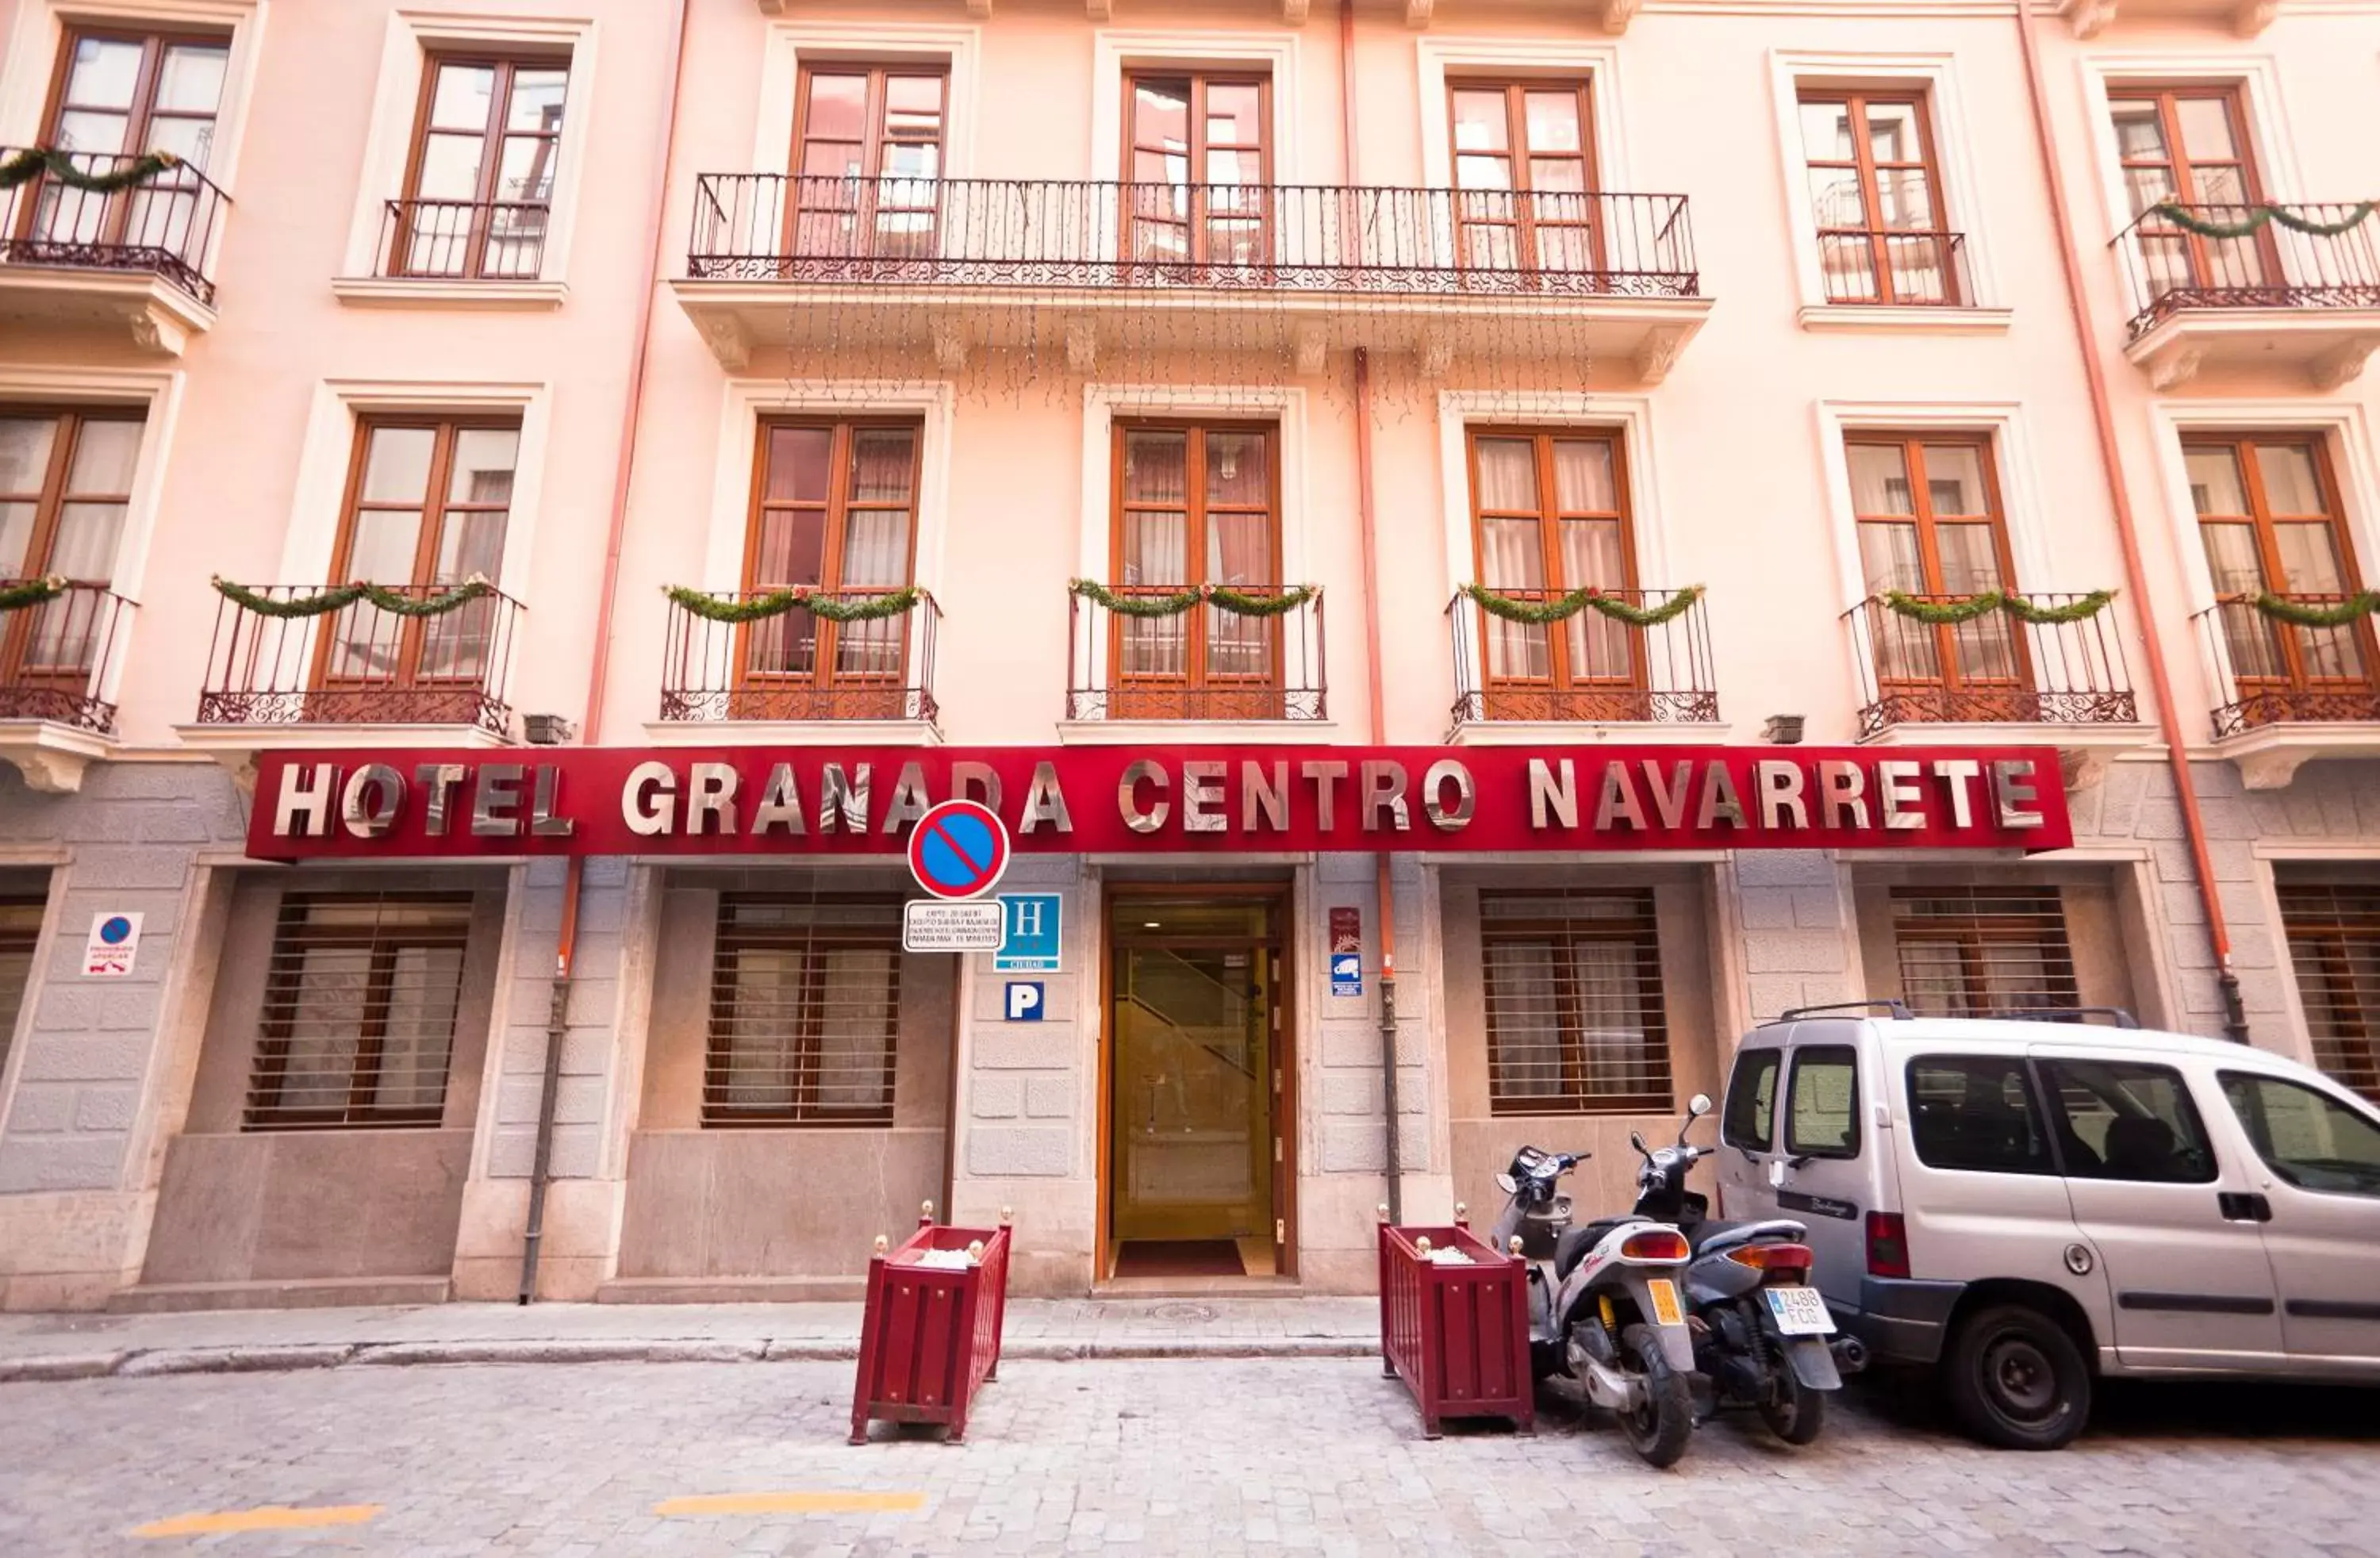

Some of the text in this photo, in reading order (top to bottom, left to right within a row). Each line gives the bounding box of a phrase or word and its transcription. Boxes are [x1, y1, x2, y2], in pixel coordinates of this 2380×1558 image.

[273, 758, 2044, 838] HOTEL GRANADA CENTRO NAVARRETE
[1012, 901, 1044, 936] H
[1010, 984, 1038, 1017] P
[1779, 1290, 1819, 1307] 2488
